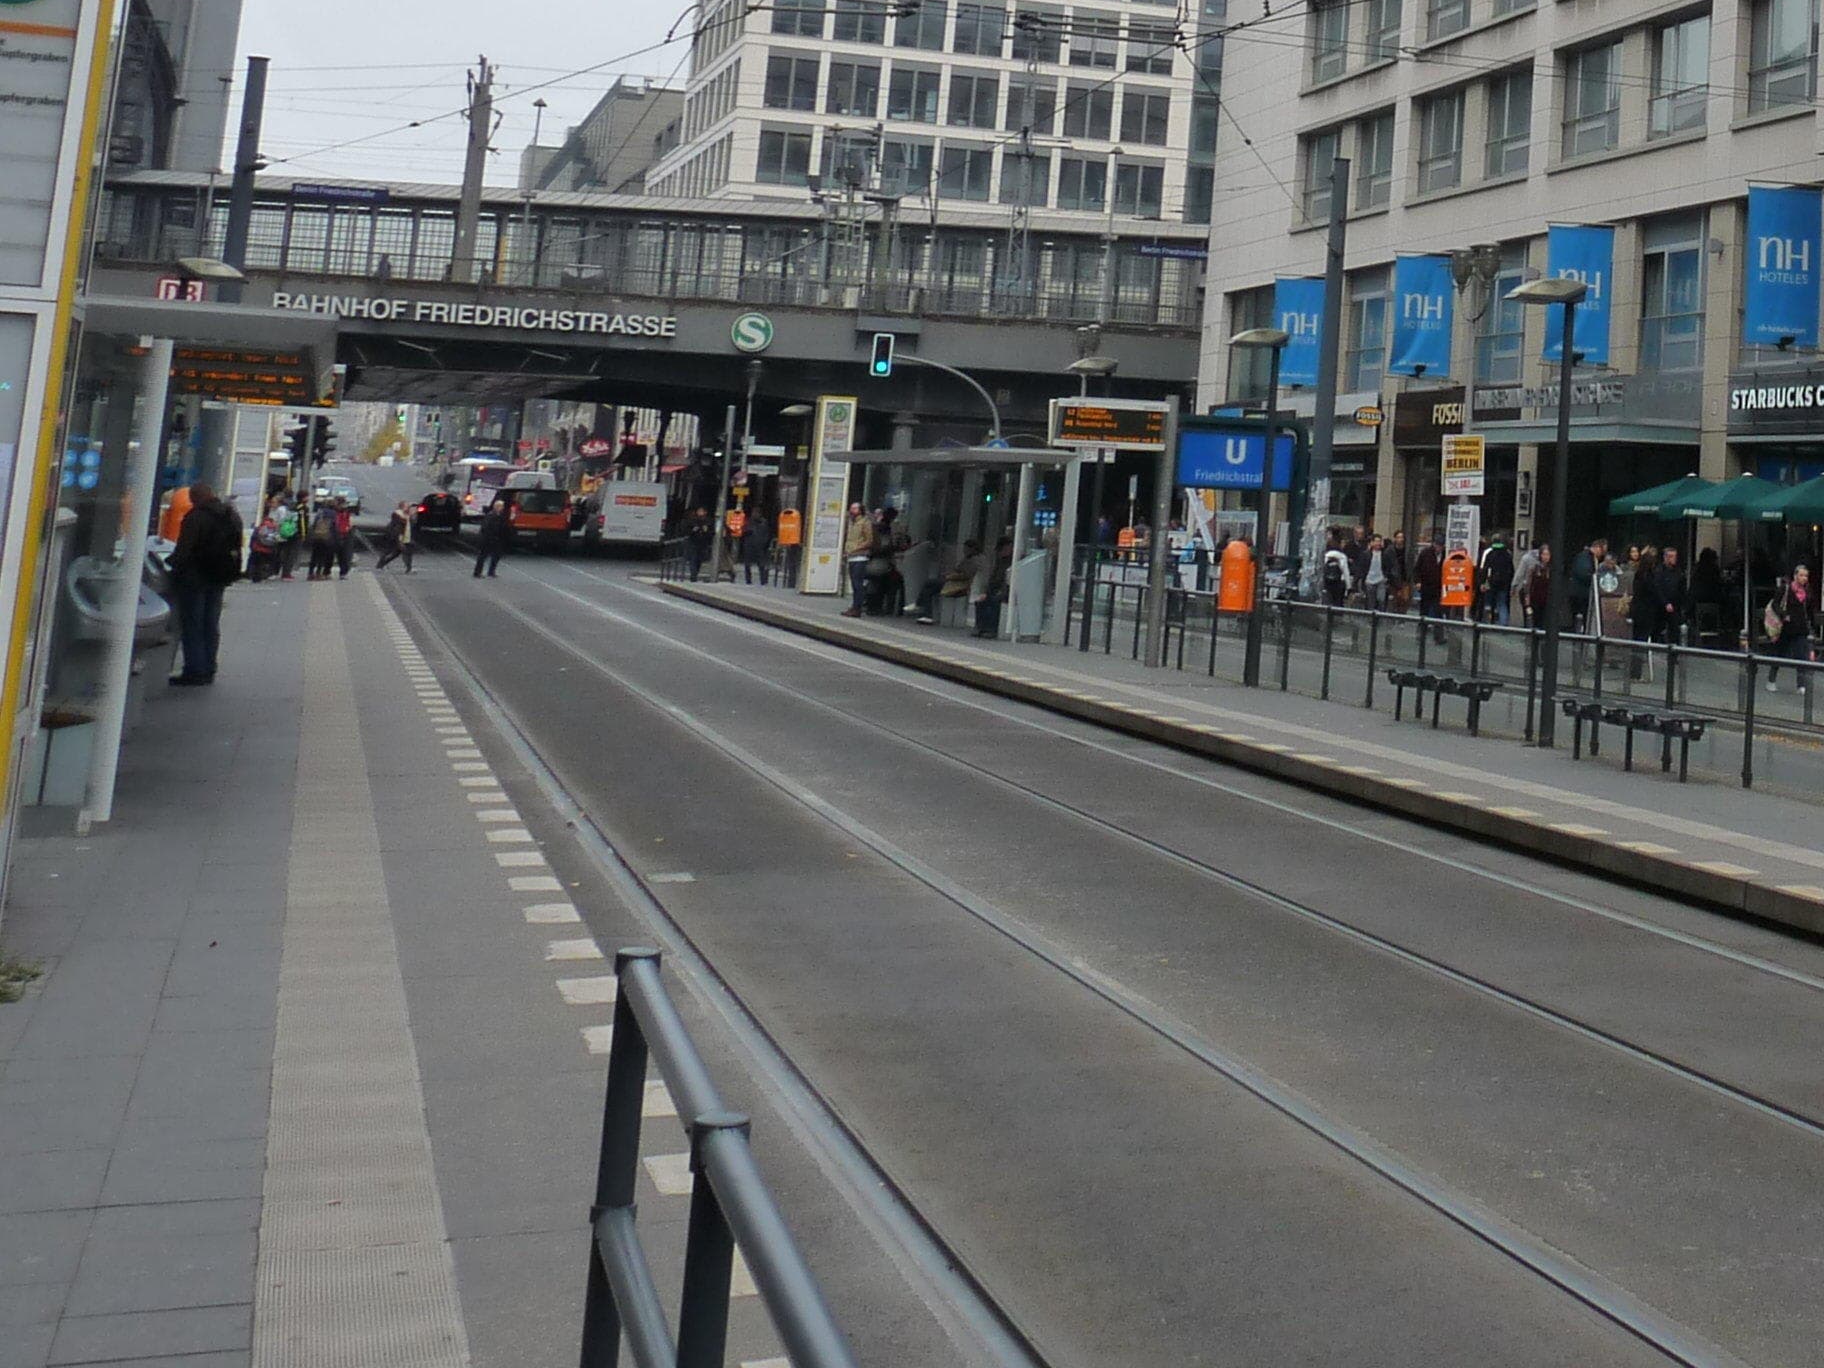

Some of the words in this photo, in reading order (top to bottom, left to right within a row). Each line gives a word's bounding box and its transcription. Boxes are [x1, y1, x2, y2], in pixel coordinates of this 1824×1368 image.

[0, 49, 68, 63] upfergraben
[1759, 272, 1809, 285] HOTELES
[273, 291, 407, 321] BAHNHOF
[414, 300, 678, 338] FRIEDRICHSTRASSE
[1731, 385, 1814, 410] STARBUCKS
[1226, 438, 1247, 466] U
[1195, 468, 1264, 484] Friedrichstra
